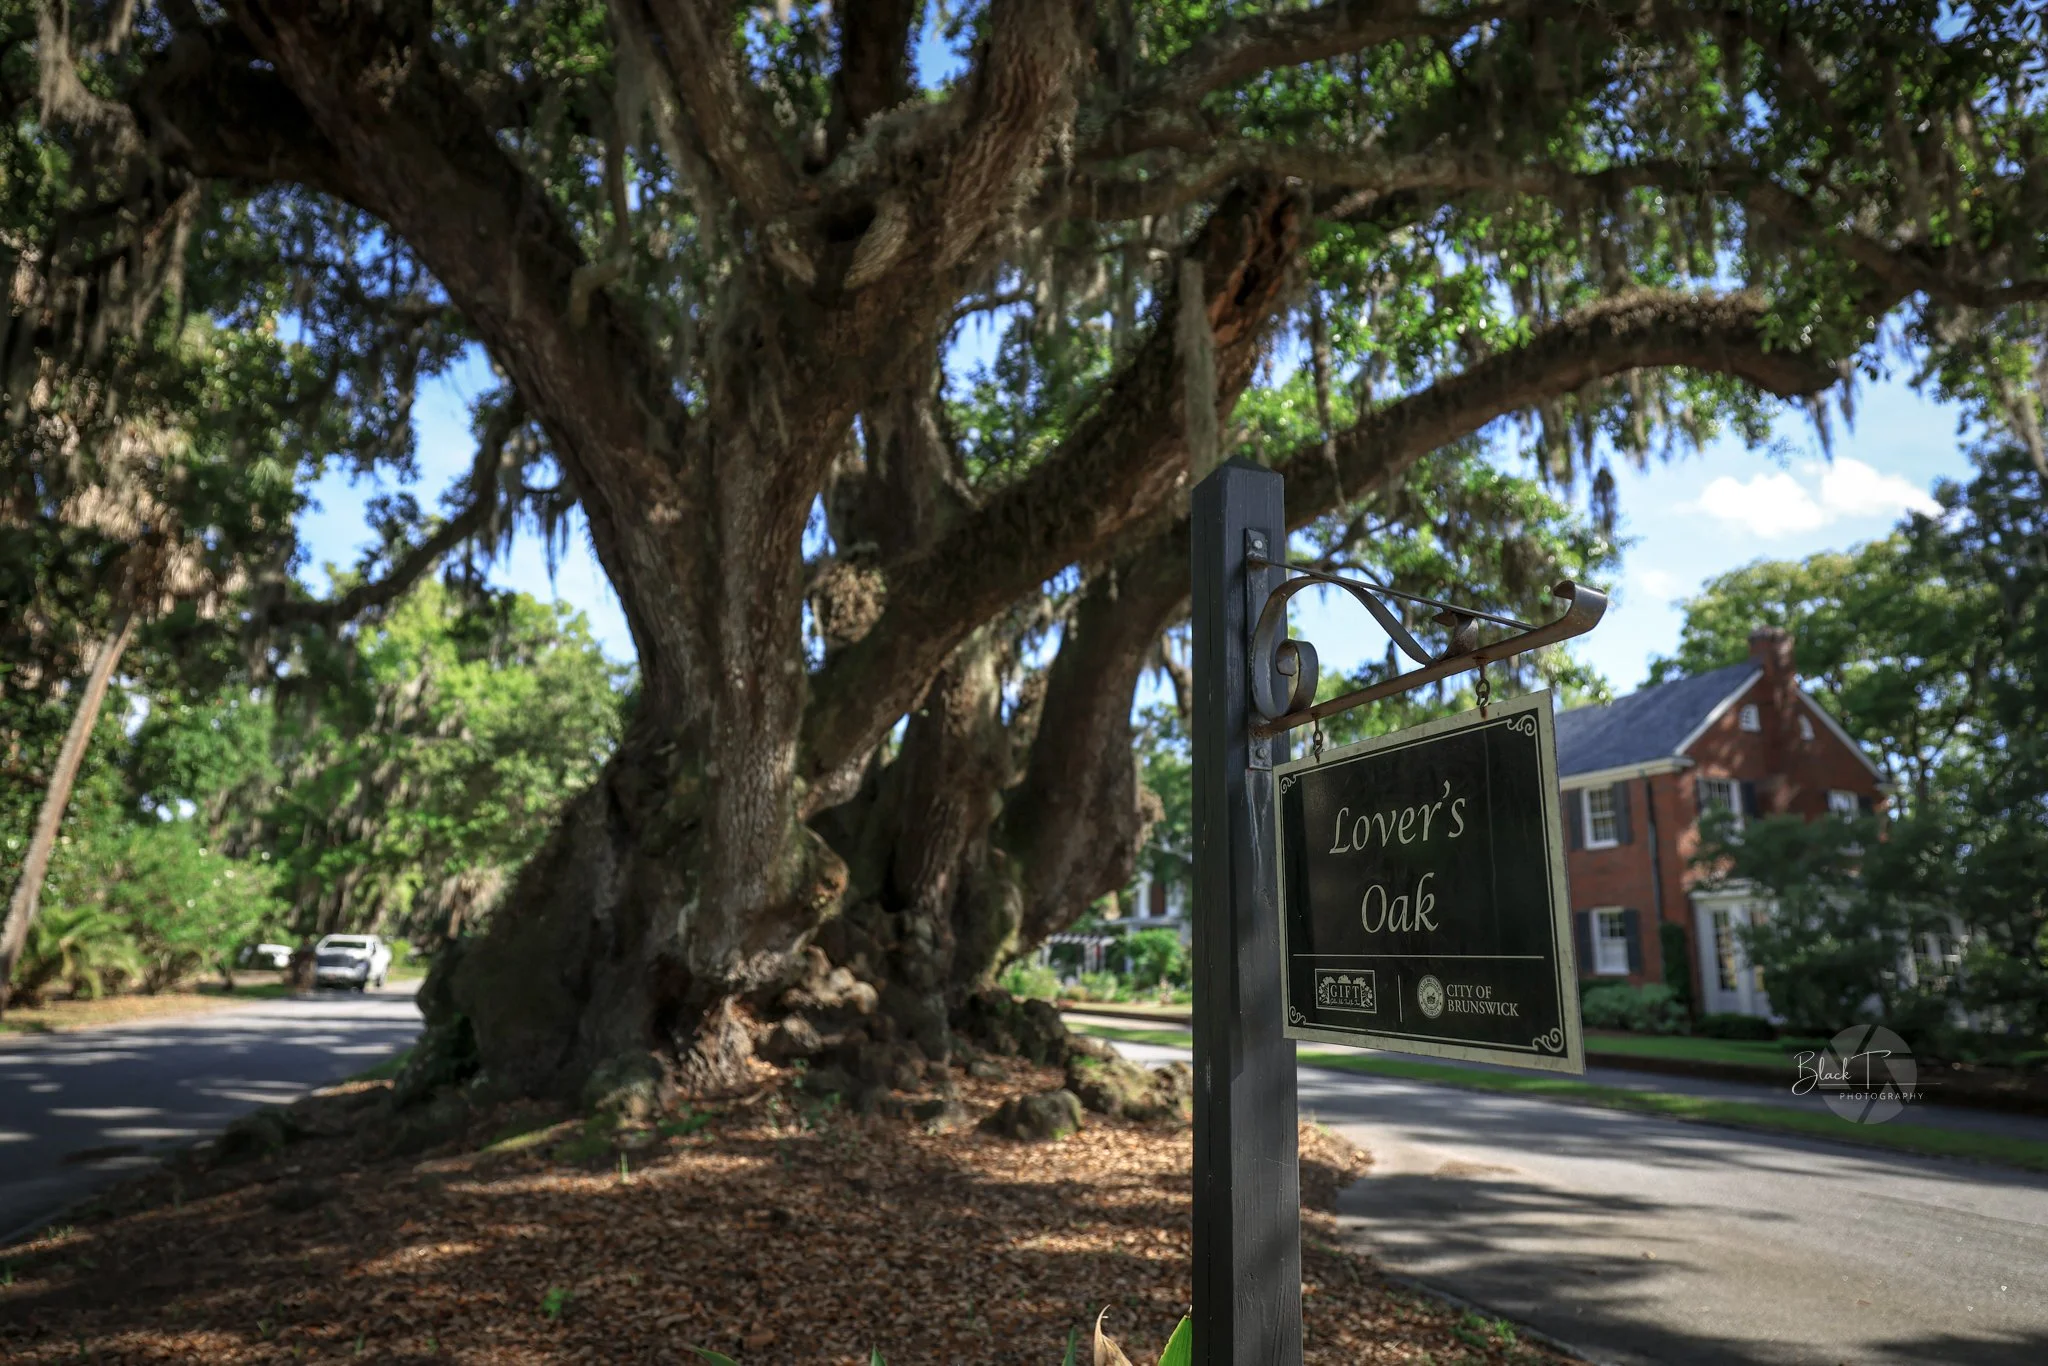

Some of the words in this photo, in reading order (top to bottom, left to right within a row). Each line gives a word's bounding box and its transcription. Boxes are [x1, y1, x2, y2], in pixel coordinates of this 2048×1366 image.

[1329, 779, 1466, 854] Lover's
[1361, 872, 1439, 933] Oak
[1330, 984, 1360, 1000] GIFT
[1446, 984, 1473, 998] CITY
[1475, 985, 1492, 999] OF
[1448, 1000, 1519, 1017] BRUNSWICK
